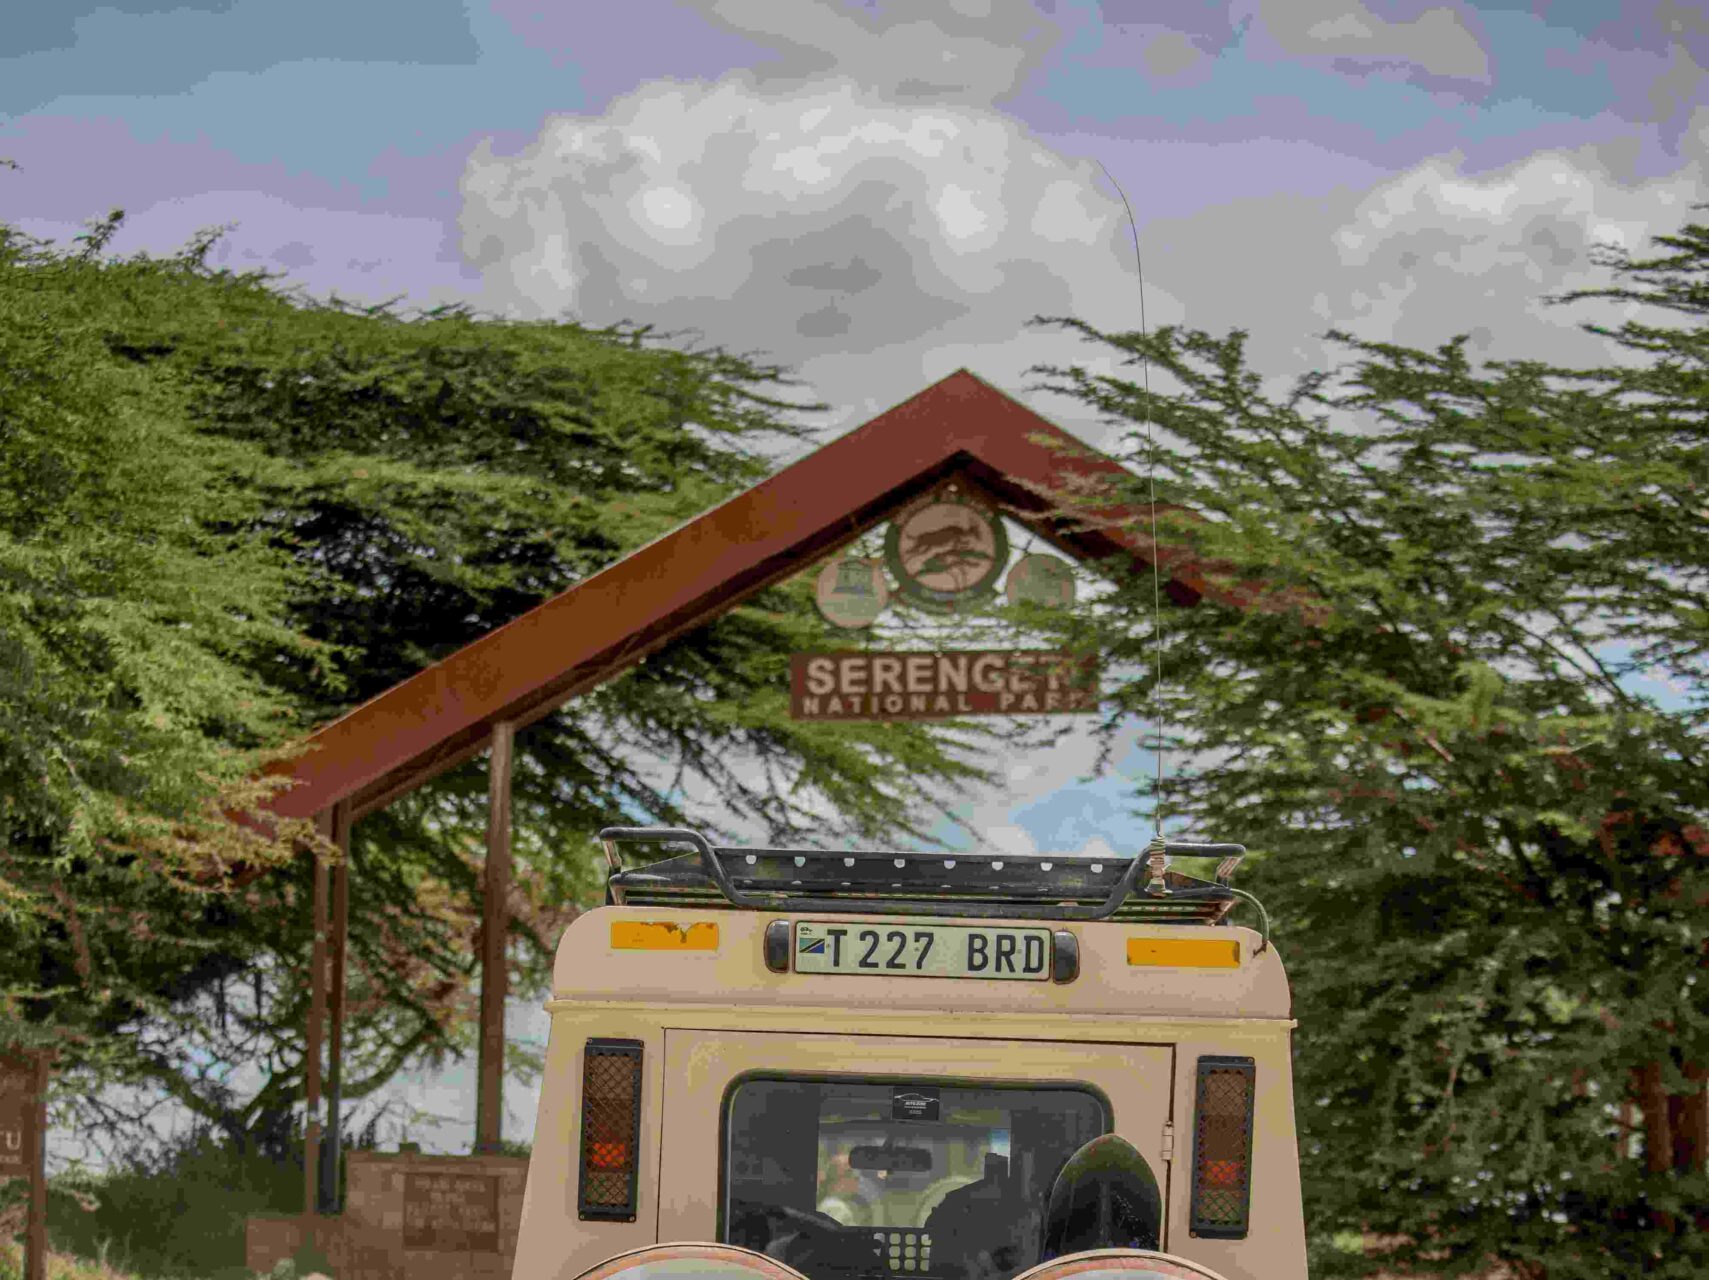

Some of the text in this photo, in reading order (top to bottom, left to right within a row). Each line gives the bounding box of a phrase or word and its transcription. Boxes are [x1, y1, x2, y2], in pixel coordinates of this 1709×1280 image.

[806, 655, 1082, 694] SERENGET
[803, 694, 972, 715] NATIONAL
[827, 929, 1045, 974] T 227 BRD
